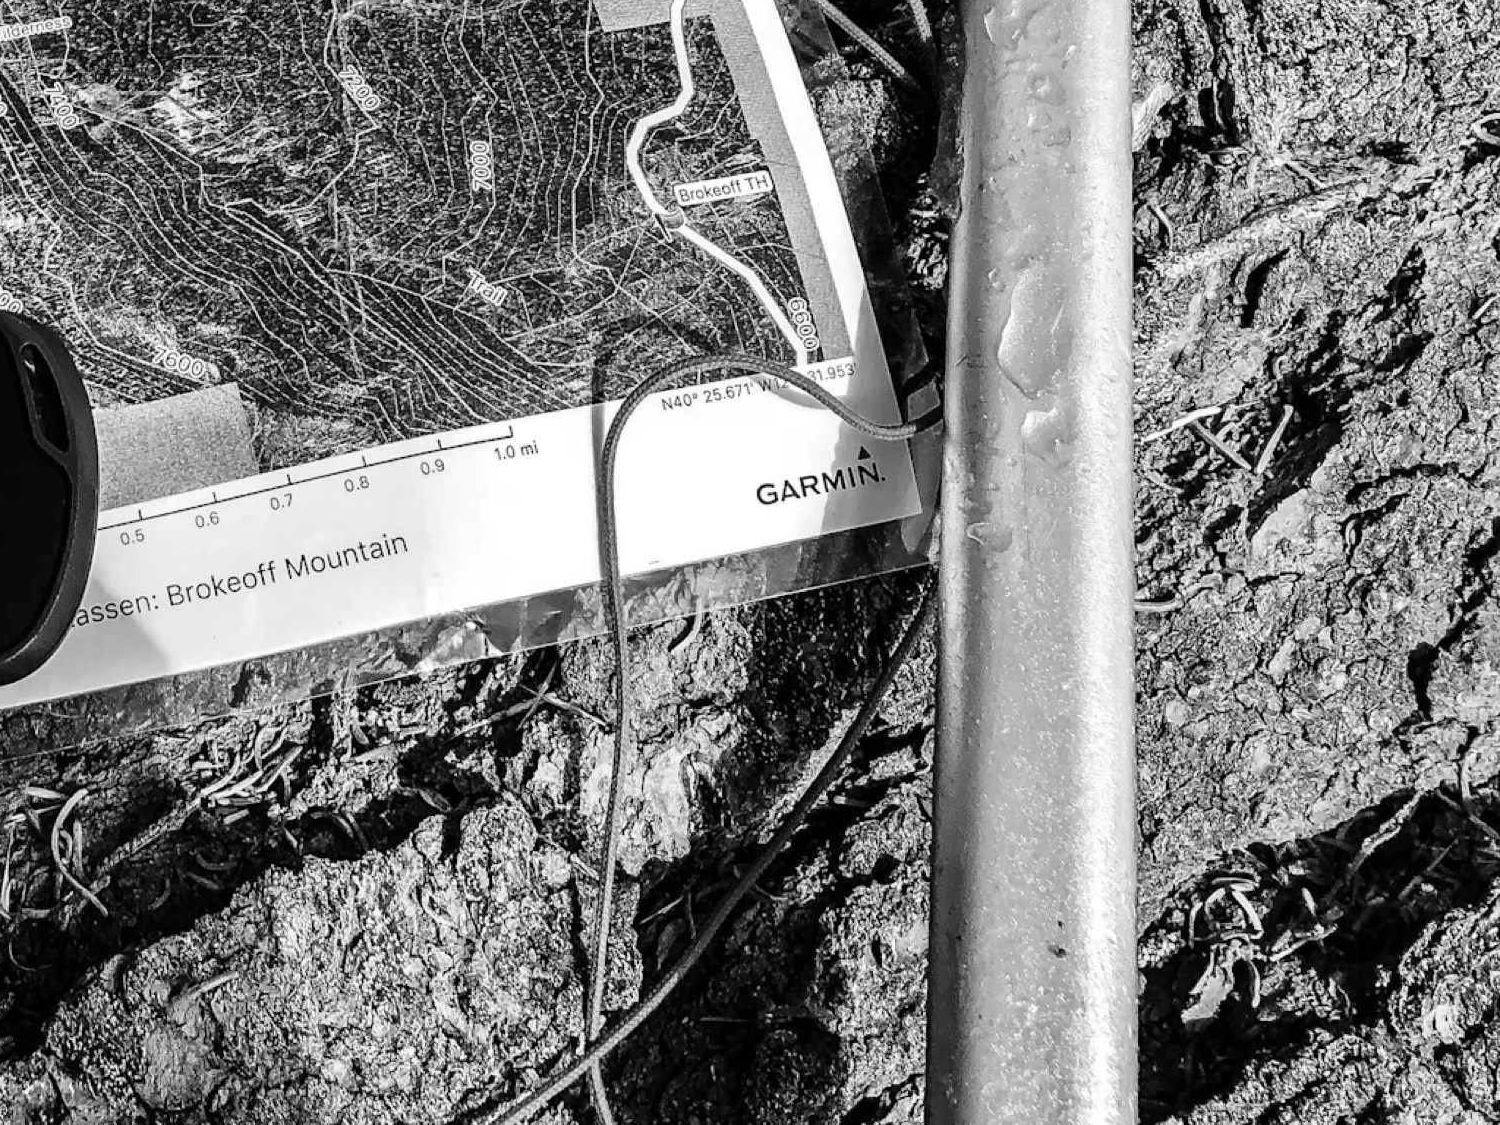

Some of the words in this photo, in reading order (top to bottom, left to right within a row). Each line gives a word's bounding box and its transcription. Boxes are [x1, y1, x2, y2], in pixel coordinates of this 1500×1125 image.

[340, 66, 380, 111] 7200
[44, 82, 79, 130] 7400
[470, 140, 493, 191] 7000
[679, 179, 741, 203] Brokeoff
[745, 175, 770, 190] TH
[467, 268, 509, 306] Trail
[787, 297, 820, 352] 6600
[152, 345, 205, 377] 7600
[661, 392, 698, 411] N40°
[494, 442, 517, 461] 1.0
[520, 439, 540, 457] mi
[420, 458, 446, 476] 0.9
[344, 475, 371, 493] 0.8
[270, 493, 295, 511] 0.7
[194, 511, 220, 529] 0.6
[120, 528, 146, 546] 0.5
[73, 591, 161, 628] assen:
[167, 560, 277, 607] Brokeoff
[286, 533, 409, 579] Mountain
